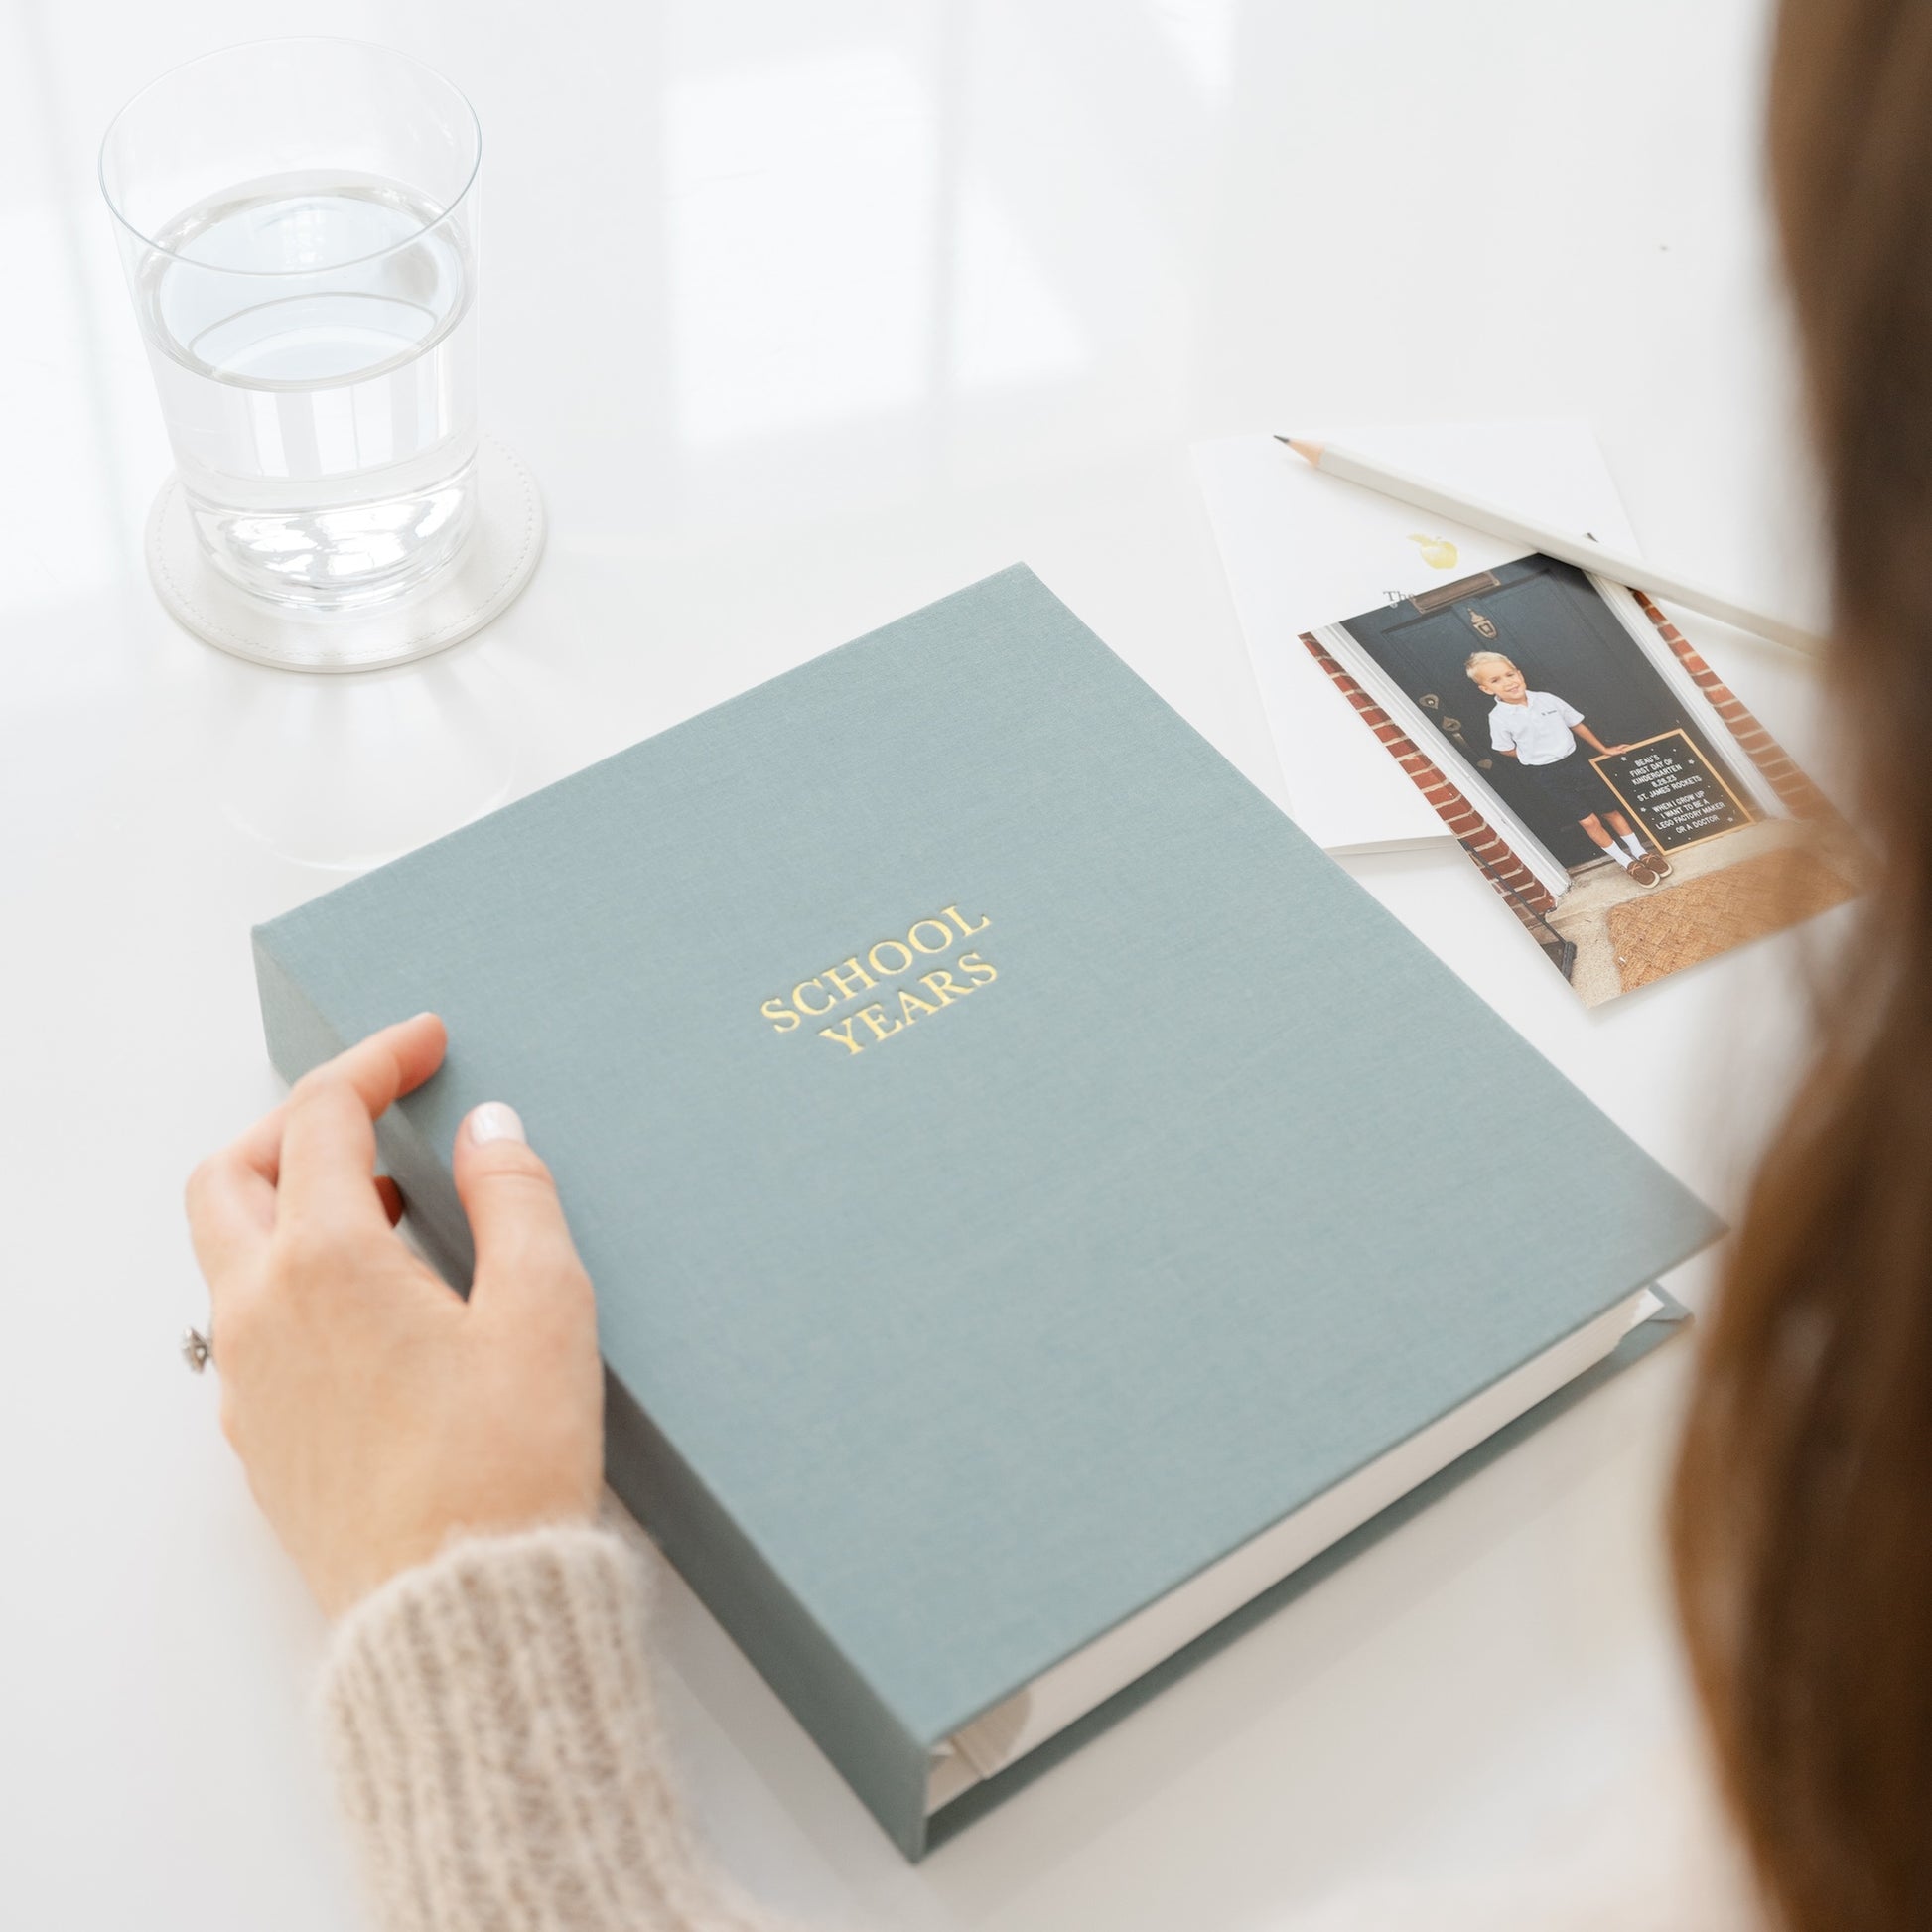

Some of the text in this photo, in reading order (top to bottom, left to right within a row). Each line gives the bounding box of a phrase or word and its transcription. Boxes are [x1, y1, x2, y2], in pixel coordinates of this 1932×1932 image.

[1629, 766, 1650, 777] FIRST
[1650, 761, 1664, 770] DAY
[1634, 755, 1660, 766] BEAU'S
[1632, 764, 1682, 785] KINDERGARTEN
[1671, 775, 1702, 790] ROCKETS
[1652, 801, 1673, 812] WHEN
[1676, 794, 1695, 805] GROW
[1655, 802, 1725, 830] LEGO FACTORY MAKER
[1664, 807, 1683, 817] WANT
[1692, 815, 1720, 828] DOCTOR
[760, 903, 992, 1034] SCHOOL
[818, 951, 998, 1056] YEARS
